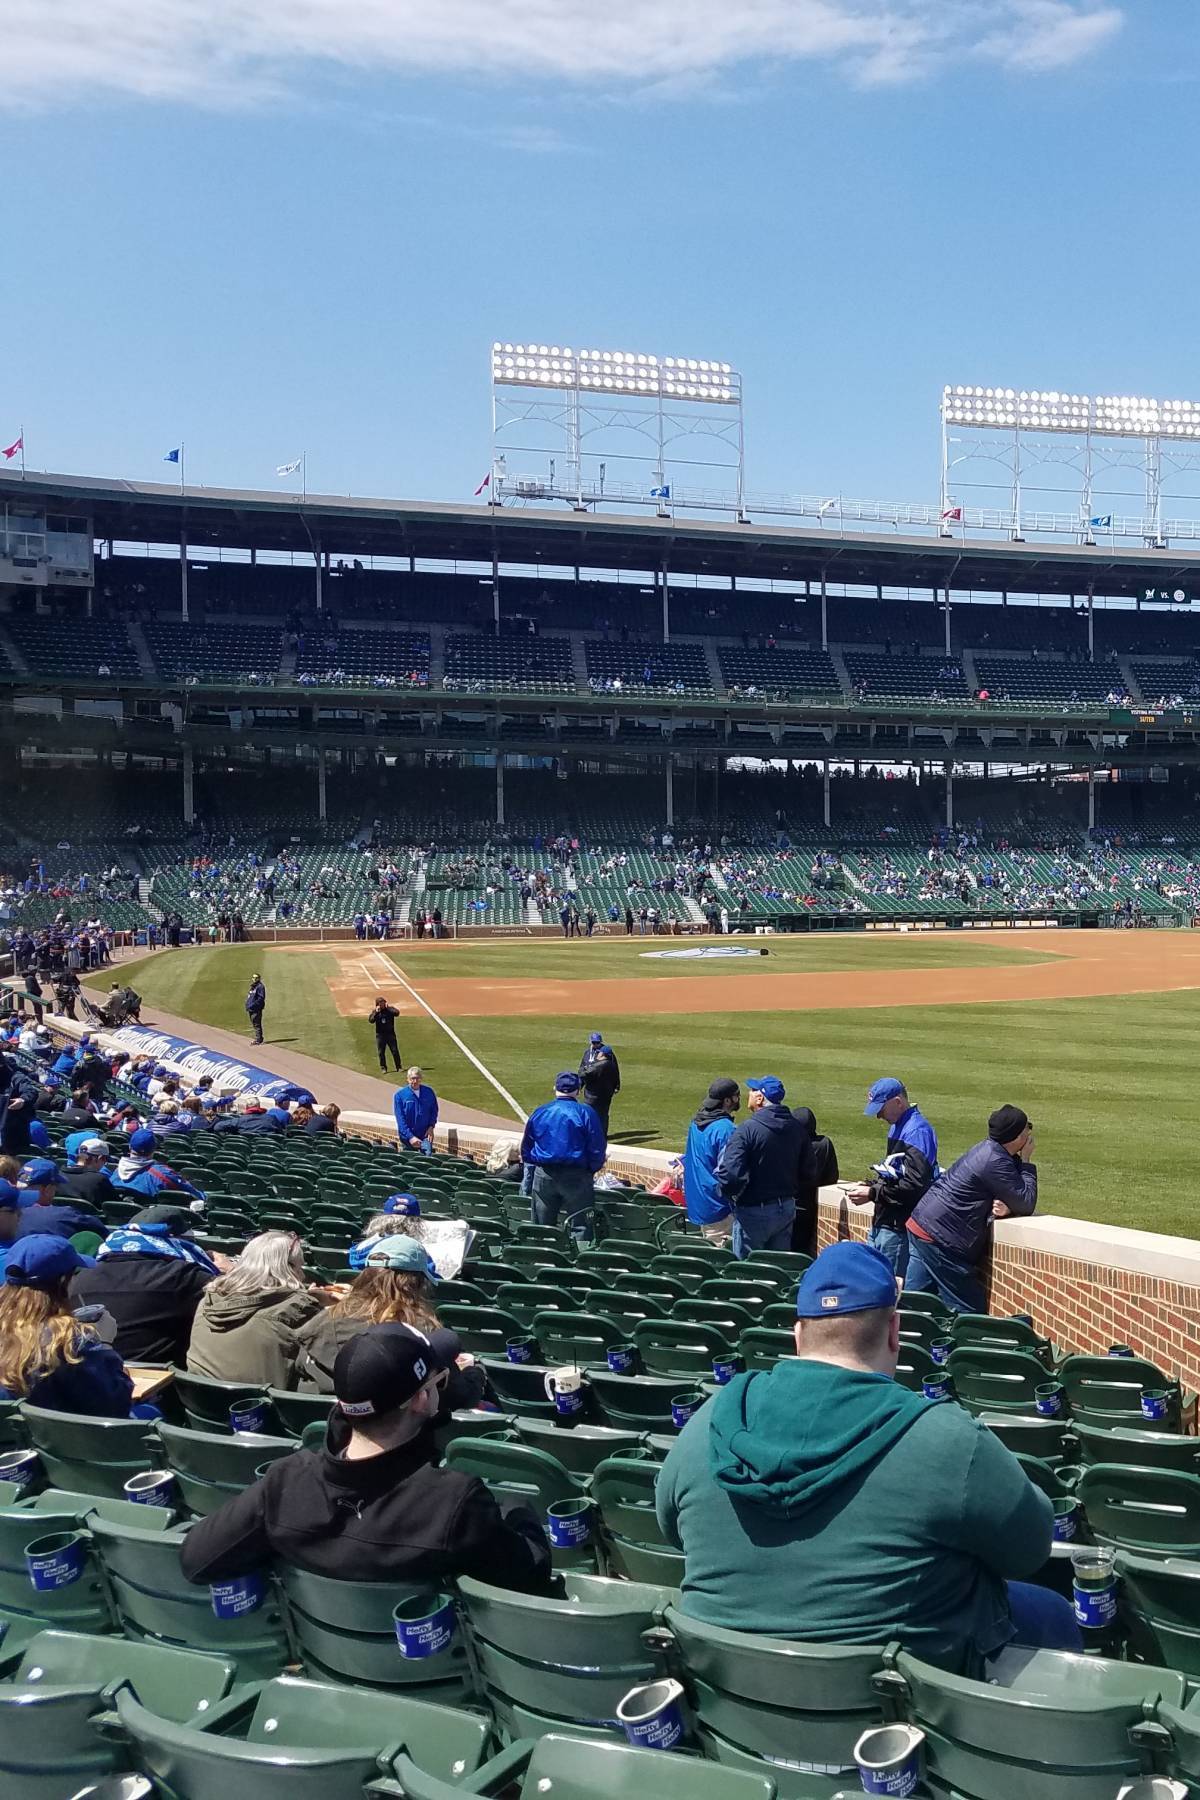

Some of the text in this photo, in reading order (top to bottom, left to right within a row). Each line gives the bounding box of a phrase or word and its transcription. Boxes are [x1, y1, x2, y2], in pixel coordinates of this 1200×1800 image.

[407, 1622, 432, 1635] Hefty
[634, 1720, 659, 1735] Hefty
[648, 1722, 672, 1743] Hefty
[887, 1770, 911, 1792] Hefty
